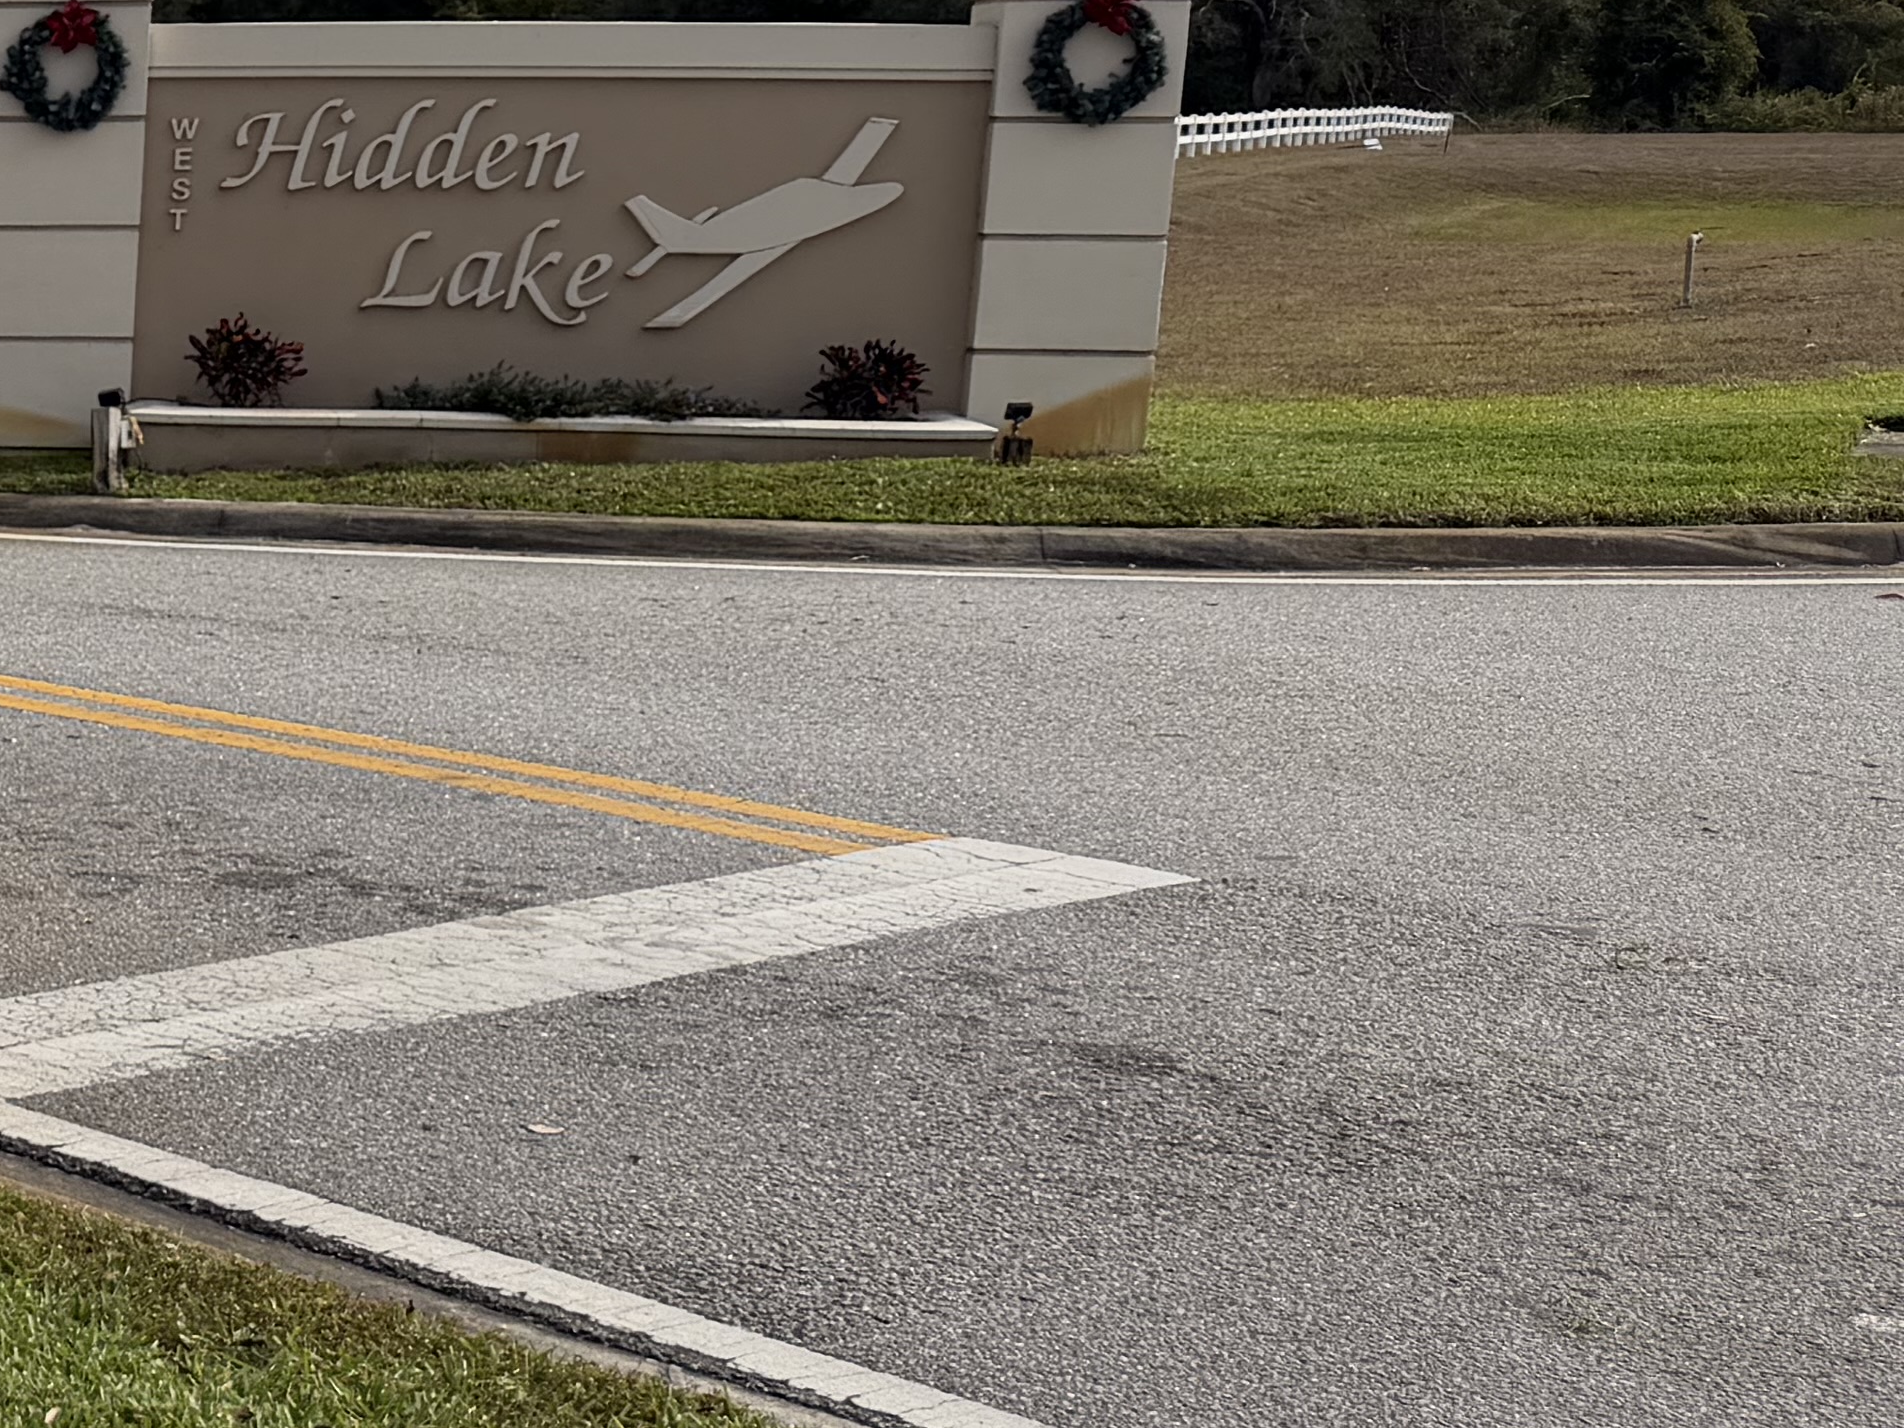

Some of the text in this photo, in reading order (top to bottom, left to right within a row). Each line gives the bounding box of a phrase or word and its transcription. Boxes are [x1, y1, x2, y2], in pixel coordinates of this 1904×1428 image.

[170, 117, 200, 231] WEST
[220, 98, 586, 191] Hidden
[359, 218, 614, 325] Lake
